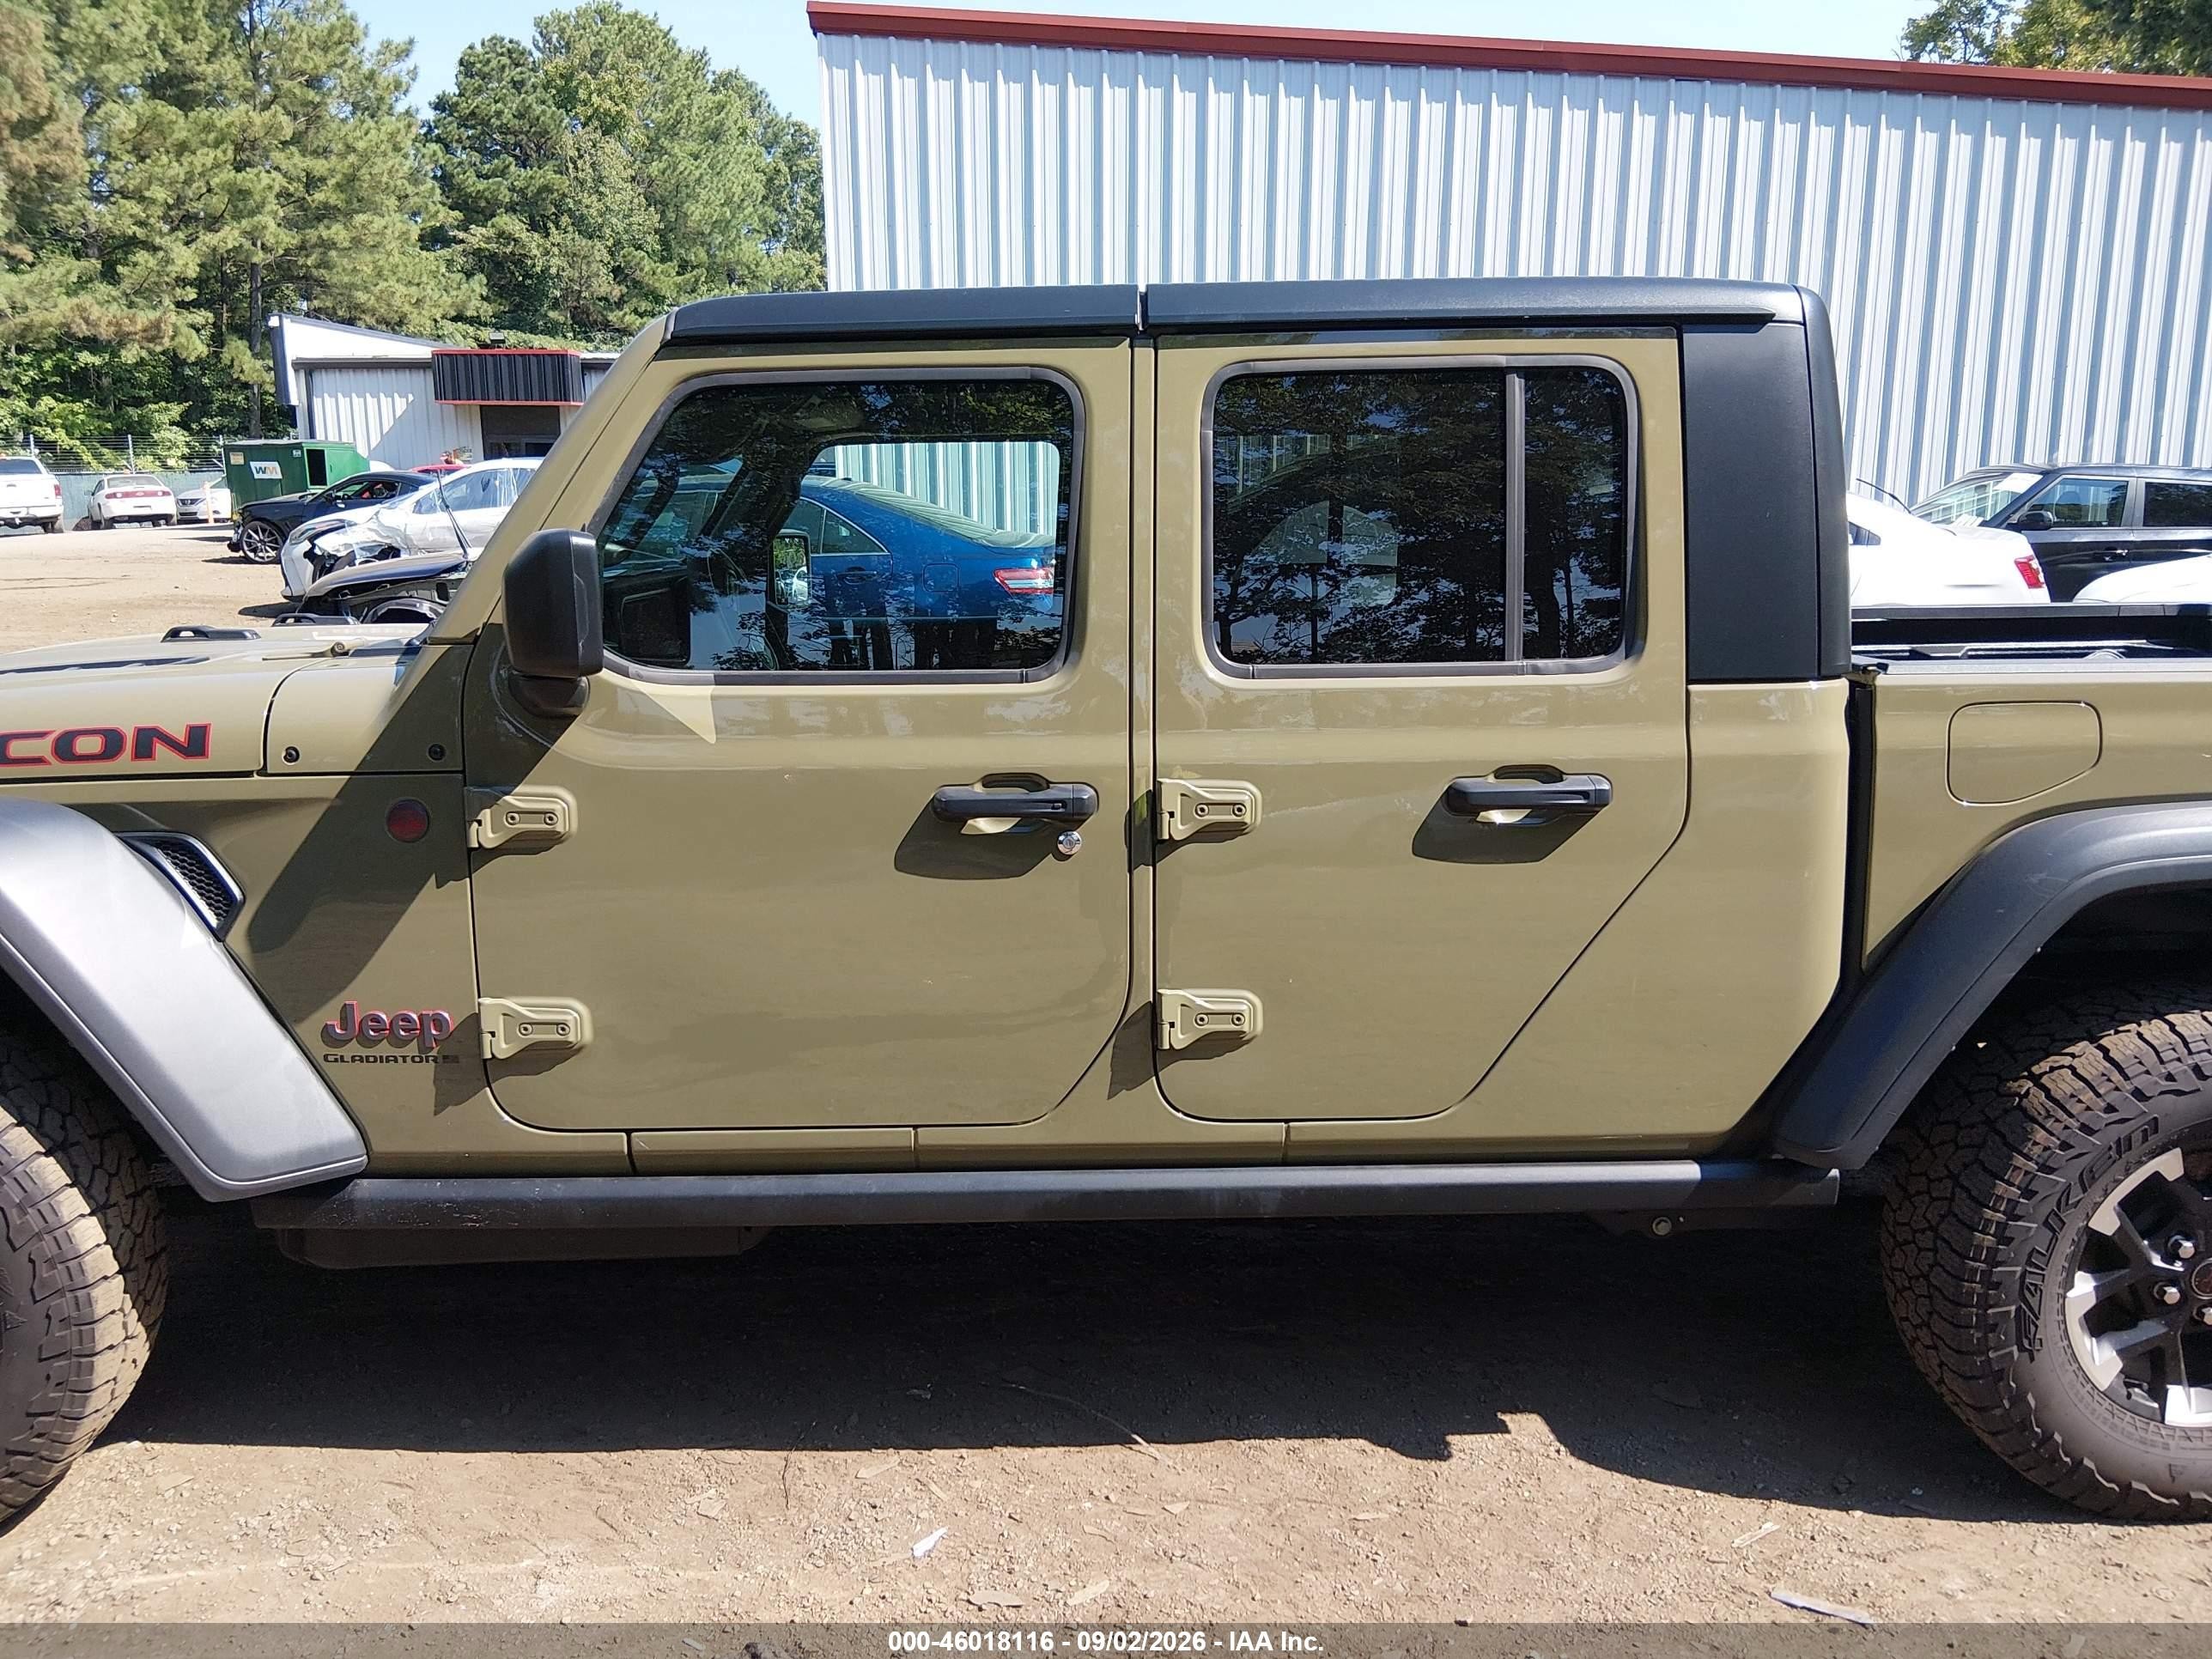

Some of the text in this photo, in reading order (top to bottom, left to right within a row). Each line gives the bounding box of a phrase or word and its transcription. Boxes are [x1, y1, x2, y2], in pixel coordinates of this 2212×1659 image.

[254, 466, 277, 475] WM
[324, 1000, 453, 1049] Jeep
[323, 1054, 440, 1065] GLADIATOR
